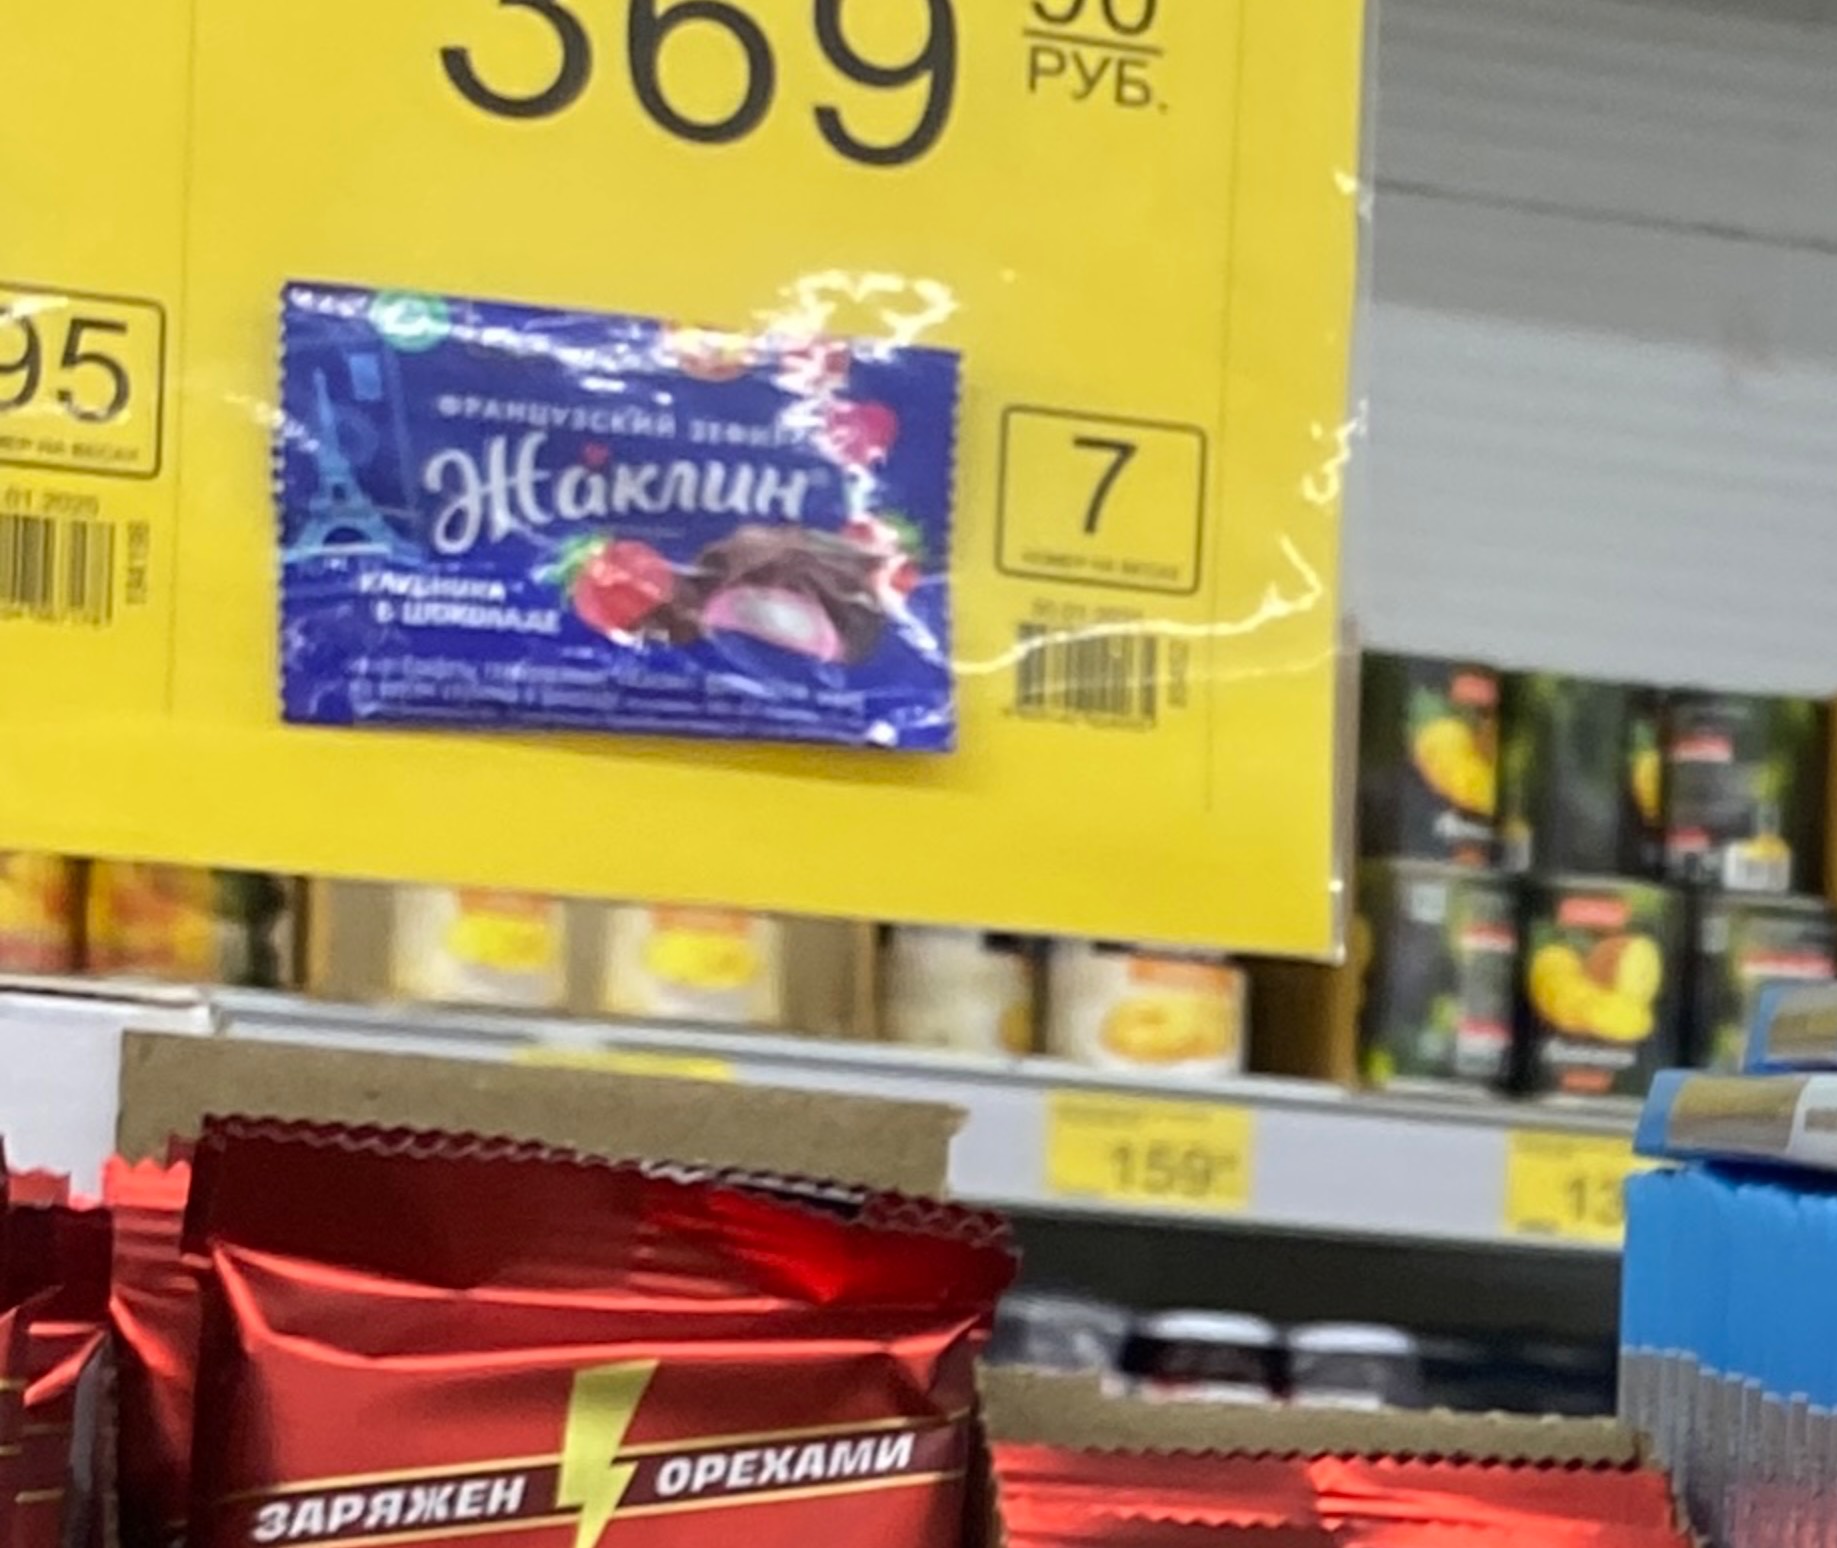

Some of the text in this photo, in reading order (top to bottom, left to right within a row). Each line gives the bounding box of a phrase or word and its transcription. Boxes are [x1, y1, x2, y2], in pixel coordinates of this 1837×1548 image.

[1027, 46, 1167, 112] РУБ.
[1071, 434, 1138, 536] 7
[251, 1433, 915, 1543] ЗАРЯЖЕН ОРЕХАМИ
